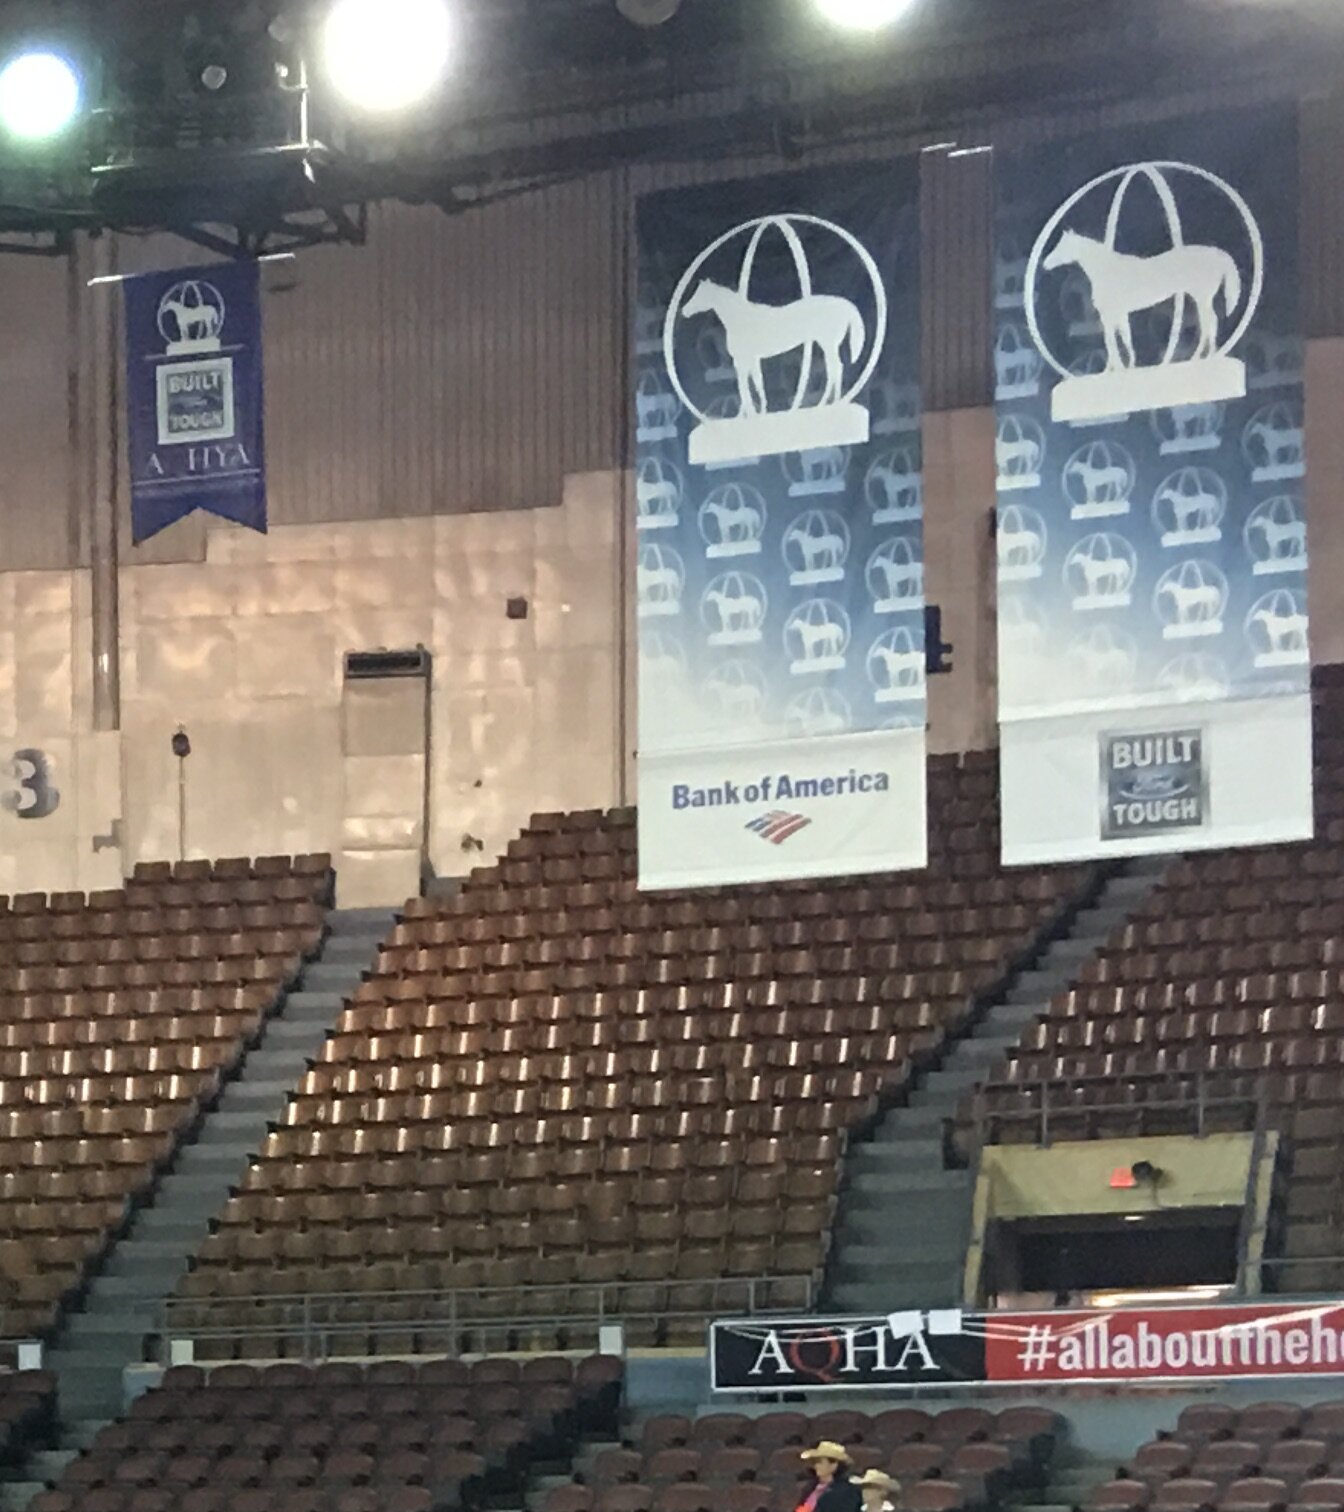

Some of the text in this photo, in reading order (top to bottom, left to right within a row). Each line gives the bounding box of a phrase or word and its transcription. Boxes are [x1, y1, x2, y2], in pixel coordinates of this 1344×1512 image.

[169, 372, 220, 393] BUILT
[1112, 736, 1199, 769] BUILT
[672, 769, 890, 810] Bank of America
[1112, 798, 1198, 826] TOUGH
[748, 1328, 941, 1383] AQHA
[1016, 1310, 1344, 1372] #allabouttheh
